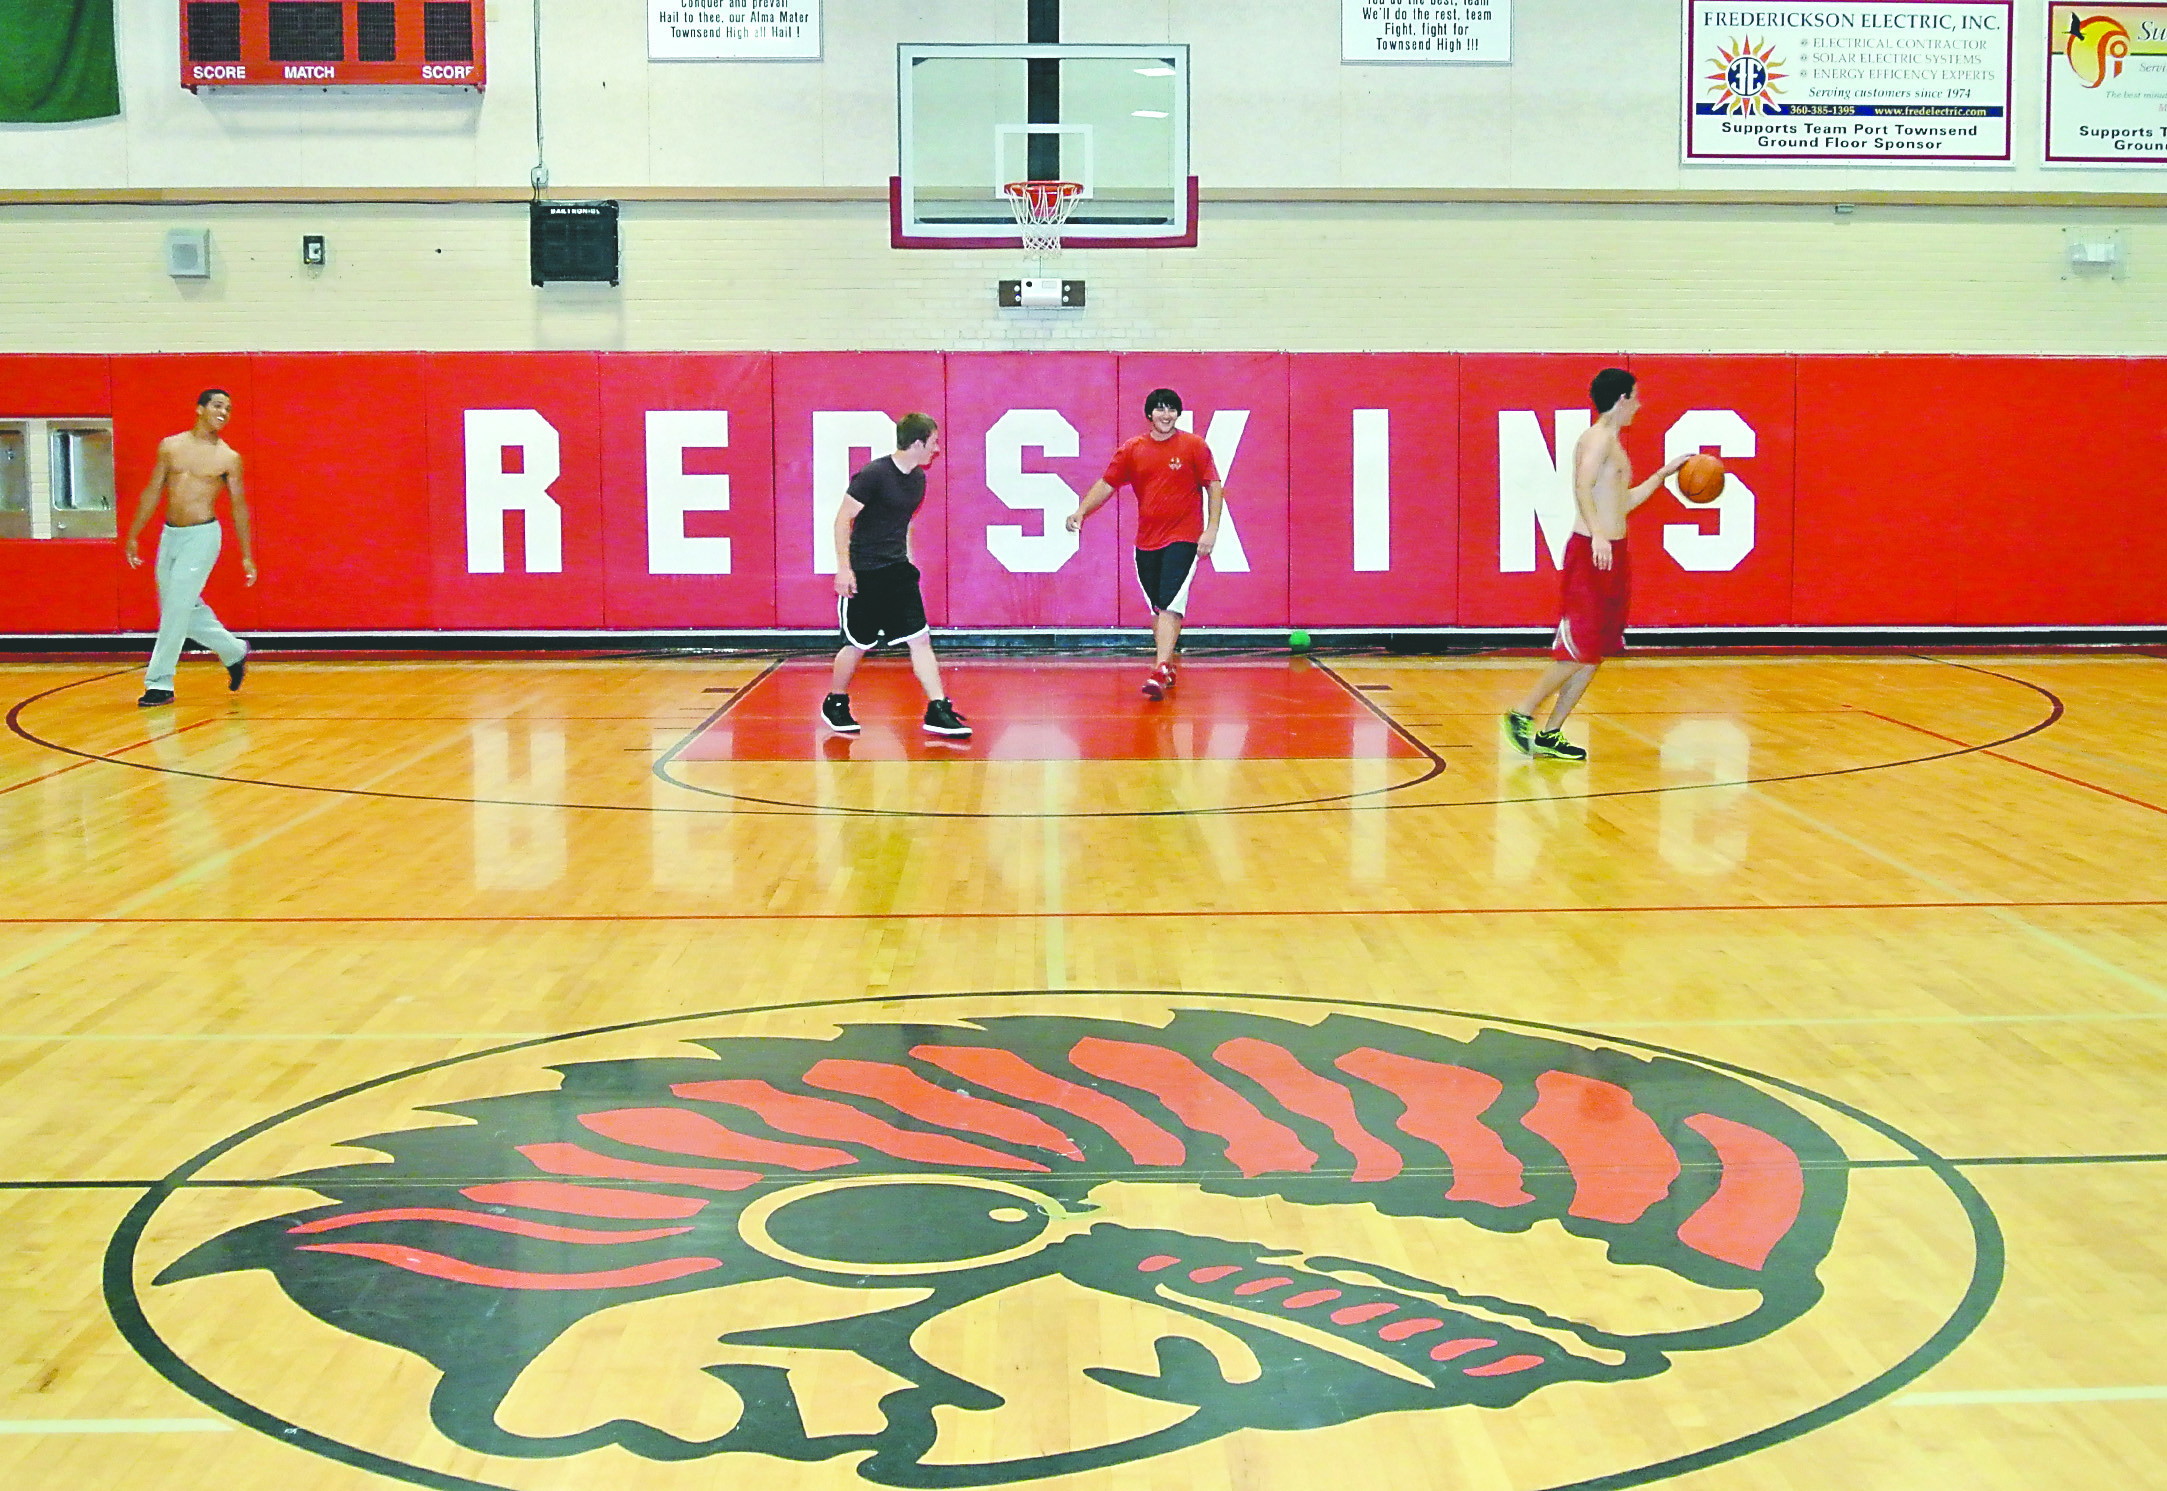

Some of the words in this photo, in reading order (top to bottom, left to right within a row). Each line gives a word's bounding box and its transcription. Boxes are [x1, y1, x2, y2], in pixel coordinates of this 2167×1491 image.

[659, 11, 679, 23] Hail
[684, 12, 694, 23] to
[729, 13, 746, 23] our
[750, 11, 775, 23] Alma
[779, 11, 809, 23] Mater
[1362, 7, 1389, 20] We'll
[1395, 8, 1407, 20] do
[1413, 8, 1430, 20] the
[1466, 8, 1492, 20] team
[1704, 12, 1855, 28] FREDERICKSON
[1861, 14, 1956, 32] ELECTRIC,
[1961, 15, 2000, 30] INC.
[671, 26, 721, 38] Townsend
[726, 26, 749, 40] High
[754, 26, 766, 38] all
[771, 26, 792, 38] Hail
[1422, 22, 1447, 37] fight
[1453, 22, 1470, 36] for
[1376, 38, 1431, 50] Townsend
[1437, 38, 1462, 52] High
[1467, 38, 1479, 50] !!!
[1813, 37, 1893, 49] ELECTRICAL
[1896, 38, 1987, 50] CONTRACTOR
[1812, 52, 1856, 63] SOLAR
[1860, 53, 1922, 64] ELECTRIC
[1925, 54, 1982, 65] SYSTEMS
[193, 66, 246, 79] SCORE
[284, 66, 335, 79] MATCH
[1813, 68, 1865, 79] ENERGY
[1869, 69, 1938, 80] EFFICENCY
[1942, 70, 1995, 81] EXPERTS
[1808, 86, 1851, 100] Serving
[1854, 88, 1911, 98] customers
[1914, 88, 1943, 98] since
[1947, 88, 1971, 98] 1974
[1790, 104, 1855, 116] 360-385-1395
[1874, 106, 1987, 117] www.fredelectric.com
[1721, 121, 1798, 135] Supports
[1804, 123, 1847, 134] Team
[1854, 124, 1888, 135] Port
[1895, 124, 1977, 136] Townsend
[2079, 125, 2153, 139] Supports
[1757, 136, 1819, 148] Ground
[1825, 137, 1868, 148] Floor
[1874, 137, 1942, 150] Sponsor
[2114, 139, 2167, 151] Groun
